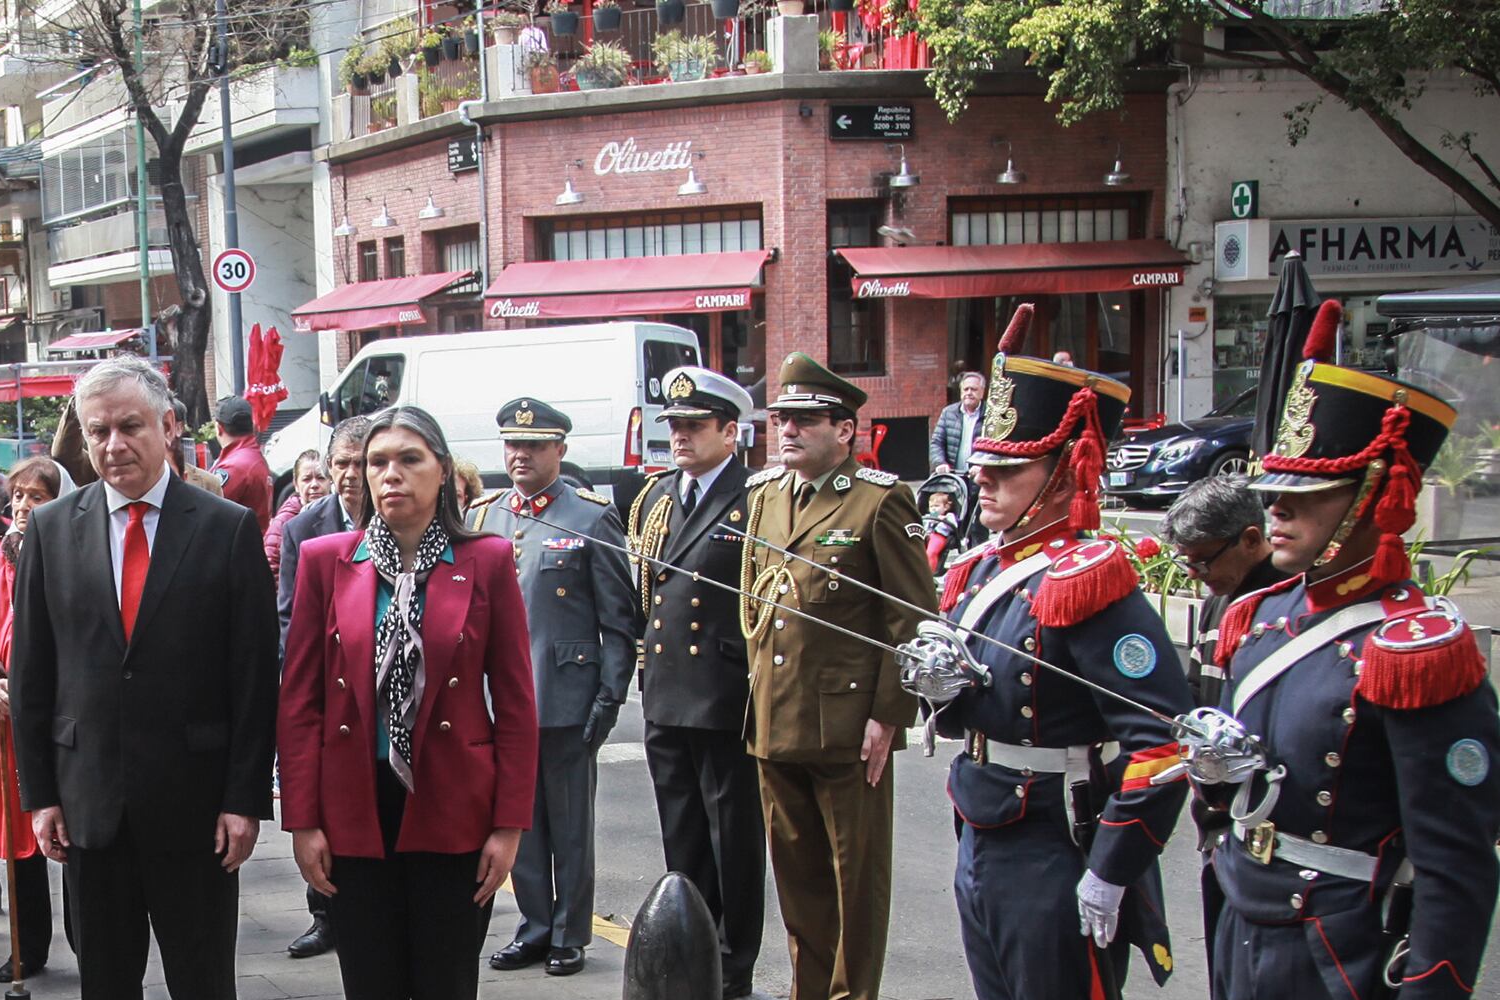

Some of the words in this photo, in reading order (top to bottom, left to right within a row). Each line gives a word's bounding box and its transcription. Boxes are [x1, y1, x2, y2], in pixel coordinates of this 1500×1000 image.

[593, 136, 692, 176] Olivetti
[1269, 224, 1466, 263] AFHARMA
[222, 262, 246, 280] 30
[1133, 272, 1179, 286] CAMPARI
[858, 281, 910, 298] Olivetti
[490, 299, 540, 318] Olivetti
[695, 294, 745, 308] CAMPARI
